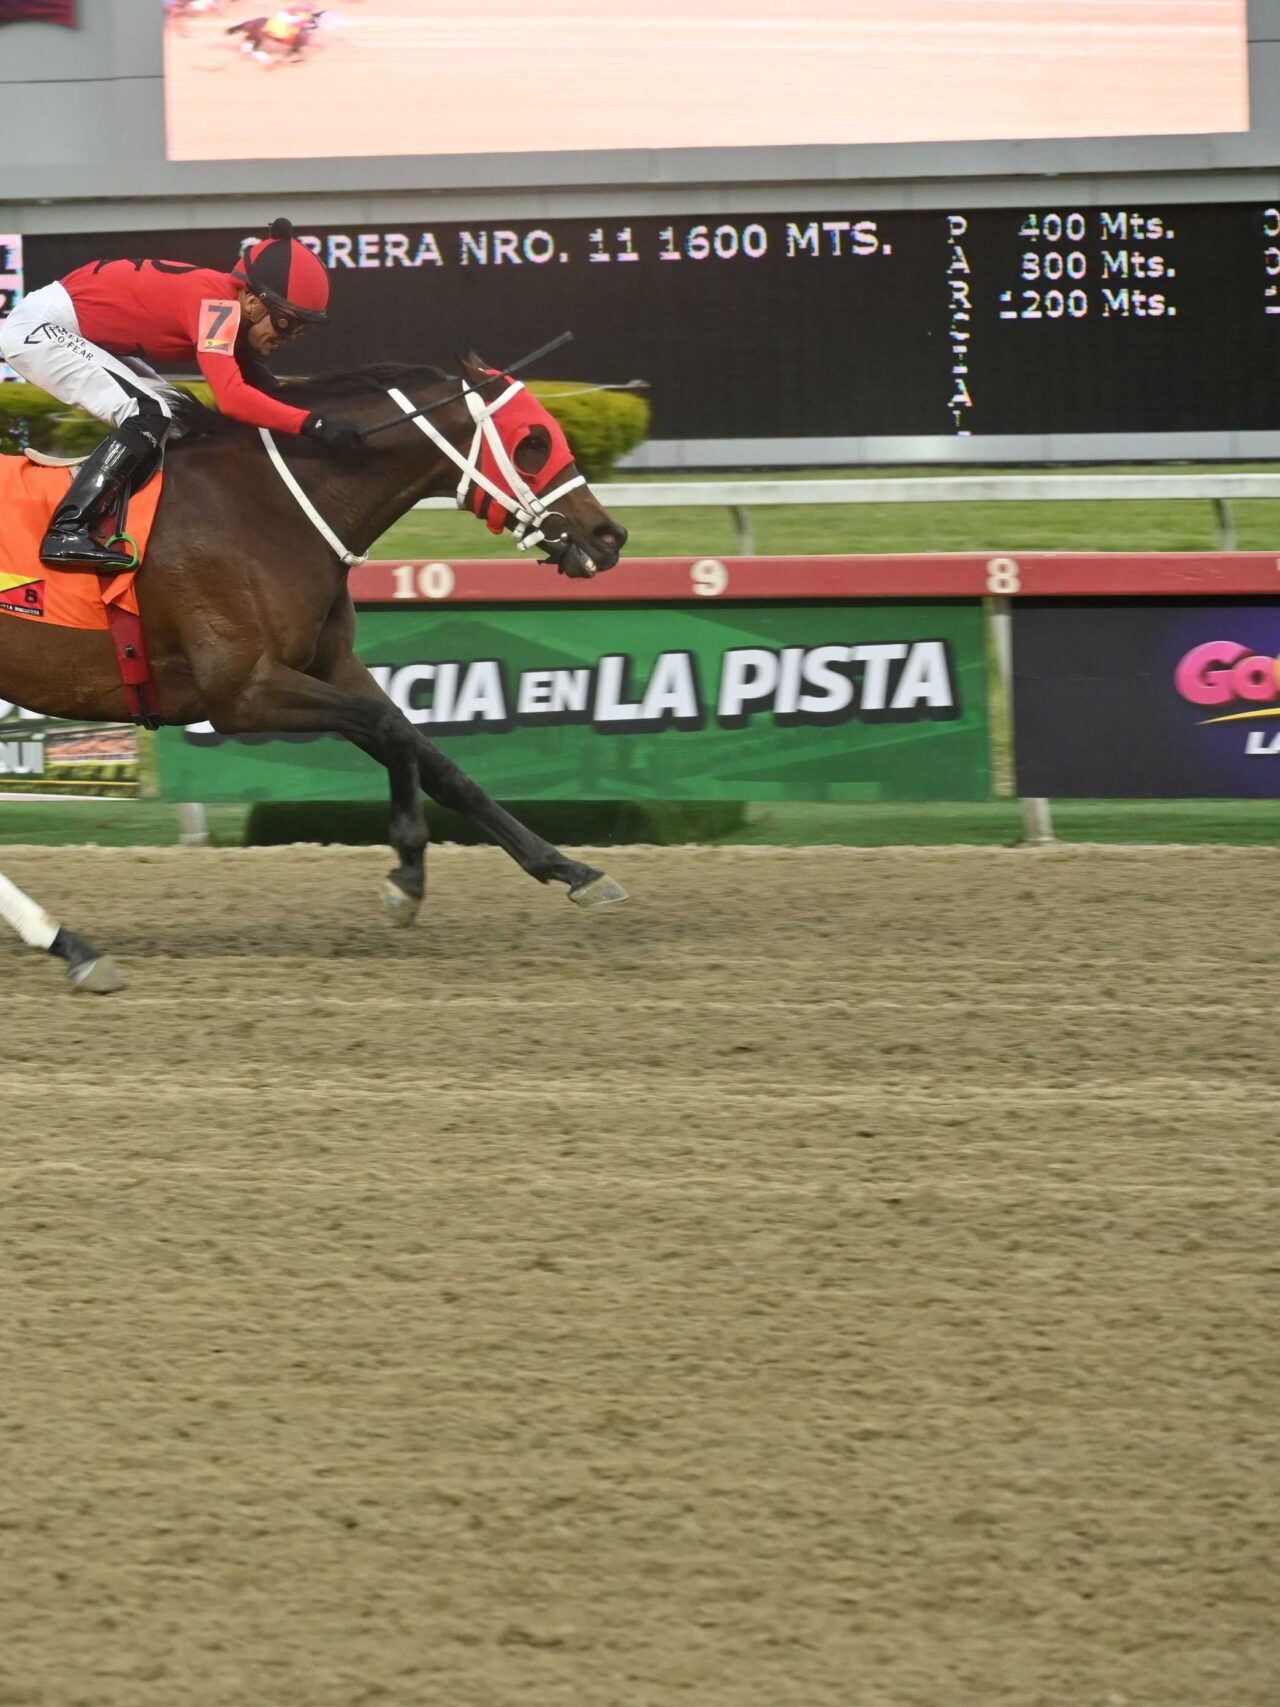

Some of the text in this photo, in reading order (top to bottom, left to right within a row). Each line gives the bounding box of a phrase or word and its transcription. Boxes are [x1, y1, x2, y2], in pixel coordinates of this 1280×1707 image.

[460, 230, 568, 264] NRO.
[589, 227, 640, 262] 11
[659, 223, 768, 260] 1600
[786, 220, 893, 257] MTS.
[1019, 212, 1175, 241] 400 Mts.
[1101, 250, 1176, 278] Mts.
[1102, 288, 1177, 317] Mts.
[206, 305, 233, 340] 7
[66, 340, 94, 361] FEAR
[391, 562, 456, 599] 10
[689, 559, 728, 597] 9
[986, 558, 1021, 595] 8
[519, 669, 591, 715] EN
[593, 653, 699, 721] LA
[719, 642, 954, 717] PISTA
[1174, 640, 1280, 706] Go
